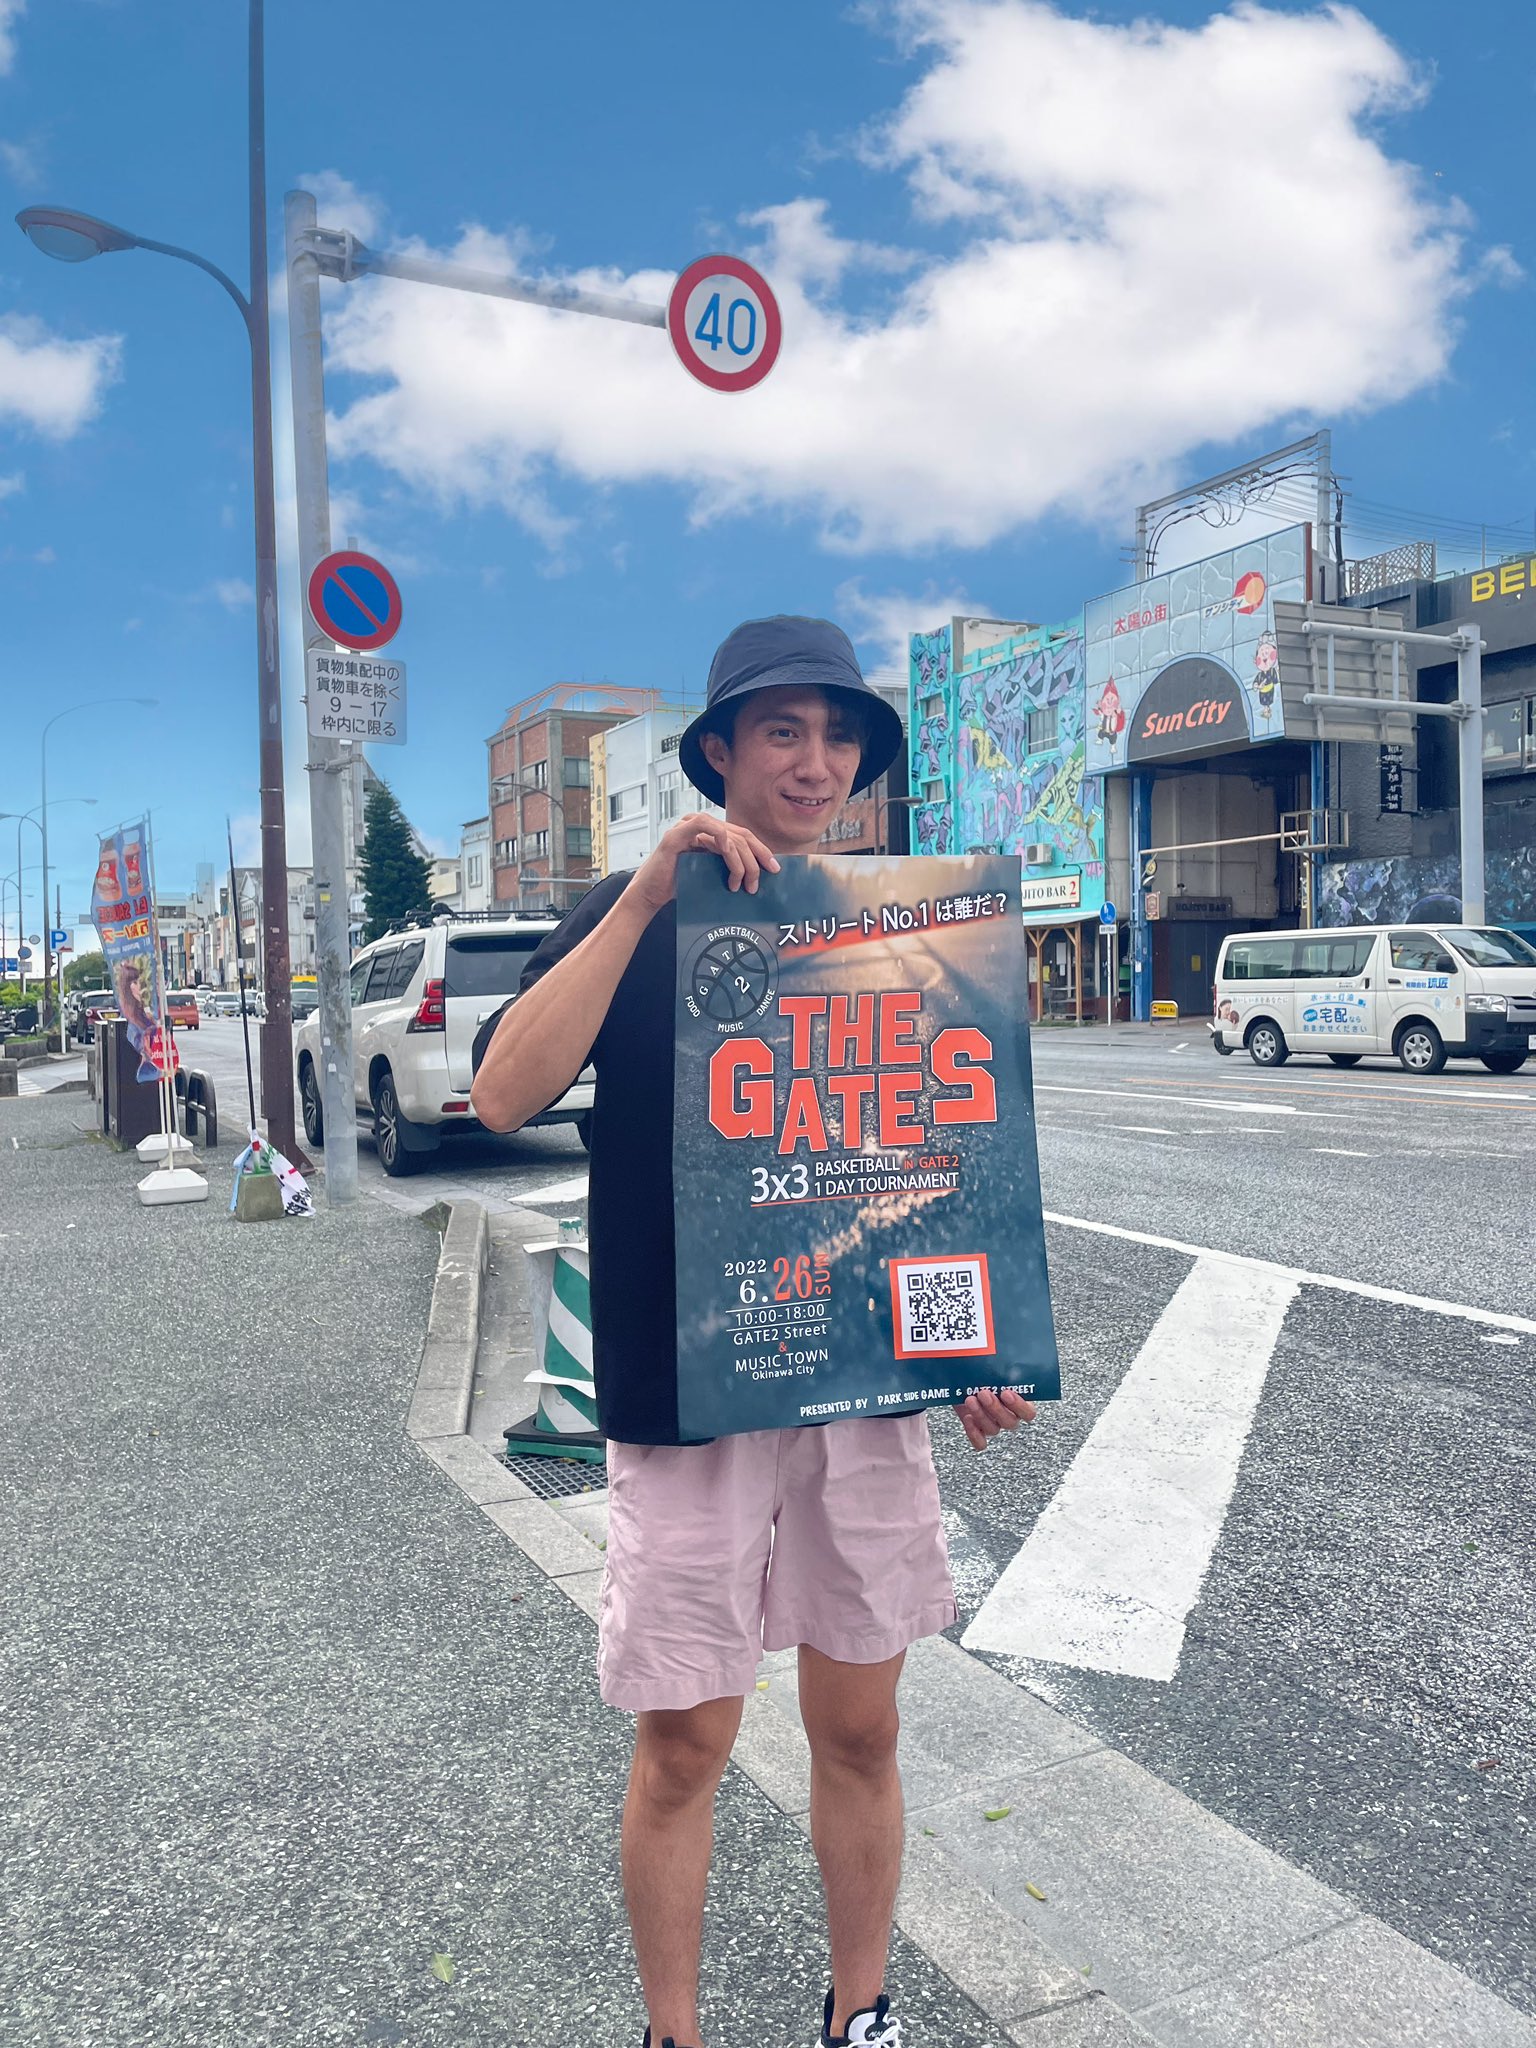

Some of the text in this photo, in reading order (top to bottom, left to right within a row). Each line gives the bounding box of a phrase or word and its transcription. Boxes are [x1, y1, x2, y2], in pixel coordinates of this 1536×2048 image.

[695, 292, 756, 356] 40
[1114, 604, 1167, 635] 太陽の街
[1205, 599, 1244, 618] サンシティ
[316, 657, 400, 681] 貨物集配中の
[316, 676, 400, 701] 貨物車を除く
[321, 714, 397, 737] 枠内に限る
[1021, 880, 1077, 900] JITO BAR 2
[707, 926, 760, 945] BASKETBALL
[778, 911, 876, 946] ストリート
[882, 902, 928, 932] No.1
[51, 930, 67, 949] P
[734, 975, 751, 994] 2
[685, 995, 701, 1018] FOOD
[756, 988, 776, 1016] DANCE
[717, 1021, 744, 1033] MUSIC
[778, 992, 922, 1070] THE
[709, 1028, 997, 1154] GATES
[815, 1155, 959, 1177] BASKETBALL IN GATE 2
[750, 1164, 809, 1203] 3x3
[814, 1172, 959, 1196] 1 DAY TOURNAMENT
[724, 1259, 767, 1277] 2022
[773, 1255, 813, 1301] 26
[814, 1253, 831, 1295] SUN
[736, 1303, 825, 1326] 10:00-18:00
[733, 1324, 827, 1345] GATE2 Street
[778, 1341, 787, 1352] &
[735, 1348, 828, 1373] MUSIC TOWN
[752, 1365, 815, 1380] Okinawa City
[800, 1401, 851, 1417] PRESENTED
[855, 1398, 868, 1410] BY
[877, 1392, 902, 1406] PARK
[903, 1391, 920, 1401] SIDE
[921, 1388, 950, 1399] GAME
